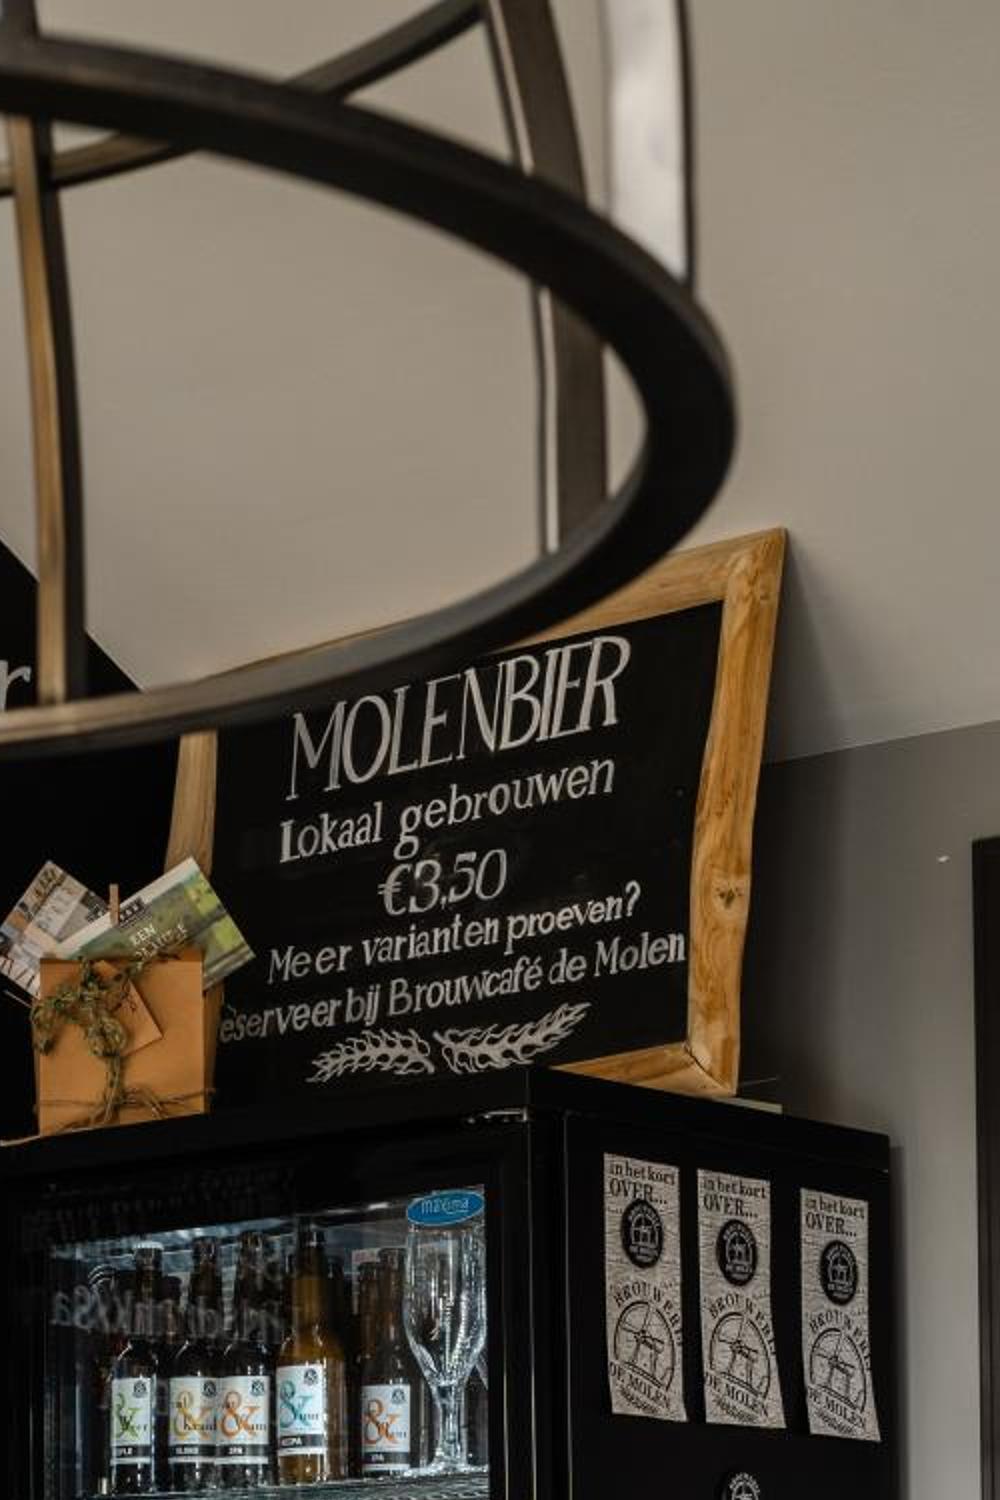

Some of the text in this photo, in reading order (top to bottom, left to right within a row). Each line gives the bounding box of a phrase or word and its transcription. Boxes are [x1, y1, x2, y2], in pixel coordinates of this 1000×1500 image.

[286, 635, 632, 800] MOLENBIER
[278, 757, 616, 864] Lokaal gebrouwen
[266, 879, 642, 985] Meer varianten proeven?
[376, 848, 508, 916] €3,50
[219, 929, 687, 1044] eserveer bij Brouwcafé de Molen
